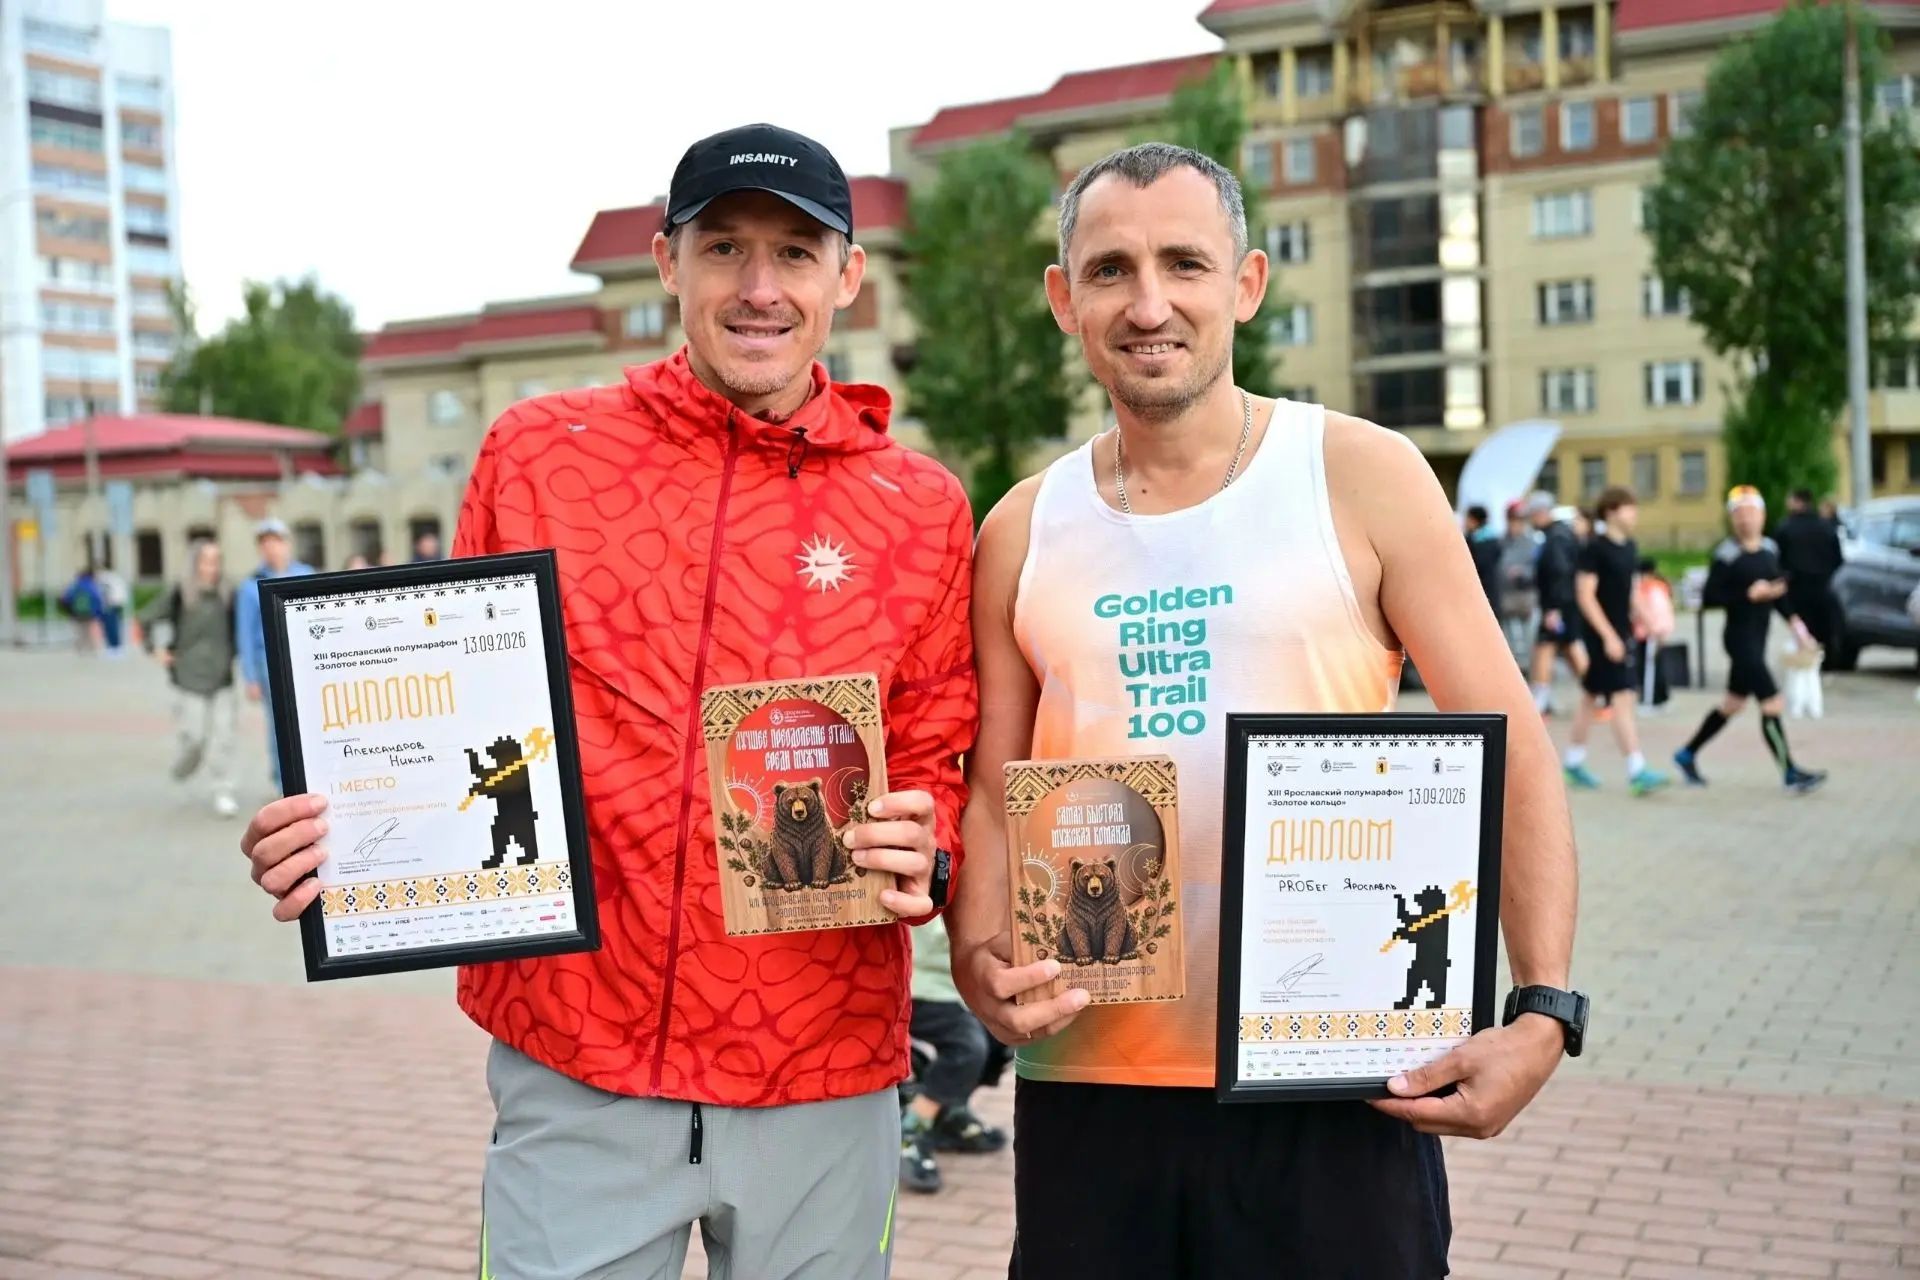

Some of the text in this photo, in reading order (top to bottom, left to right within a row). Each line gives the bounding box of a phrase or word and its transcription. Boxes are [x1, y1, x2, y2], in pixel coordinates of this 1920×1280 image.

[729, 153, 798, 167] INSANITY
[1093, 584, 1233, 618] Golden
[463, 631, 526, 654] 13.09.2026
[1119, 617, 1206, 646] Ring
[313, 640, 458, 661] XIII Ярославский полумарафон
[314, 656, 398, 671] «Золотое кольцо»
[1118, 649, 1211, 678] Ultra
[321, 671, 455, 732] ДИПЛОМ
[1125, 675, 1207, 707] Trail
[1127, 709, 1206, 738] 100
[735, 722, 856, 751] ЛУЧШЕЕ ПРЕОДОЛЕНИЕ ЭТАПА
[343, 741, 425, 758] Александров
[389, 754, 435, 767] Никита
[764, 747, 830, 772] СРЕДИ МУЖЧИН
[338, 776, 396, 793] МЕСТО
[1267, 788, 1404, 798] XIII Ярославский полумарафон
[1408, 787, 1466, 805] 13.09.2026
[1055, 802, 1124, 826] САМАЯ БЫСТРАЯ
[1310, 799, 1347, 807] кольцо»
[1051, 823, 1132, 848] МУЖСКАЯ КОМАНДА
[1266, 818, 1393, 866] ДИПЛОМ
[1343, 877, 1397, 891] Ярославль
